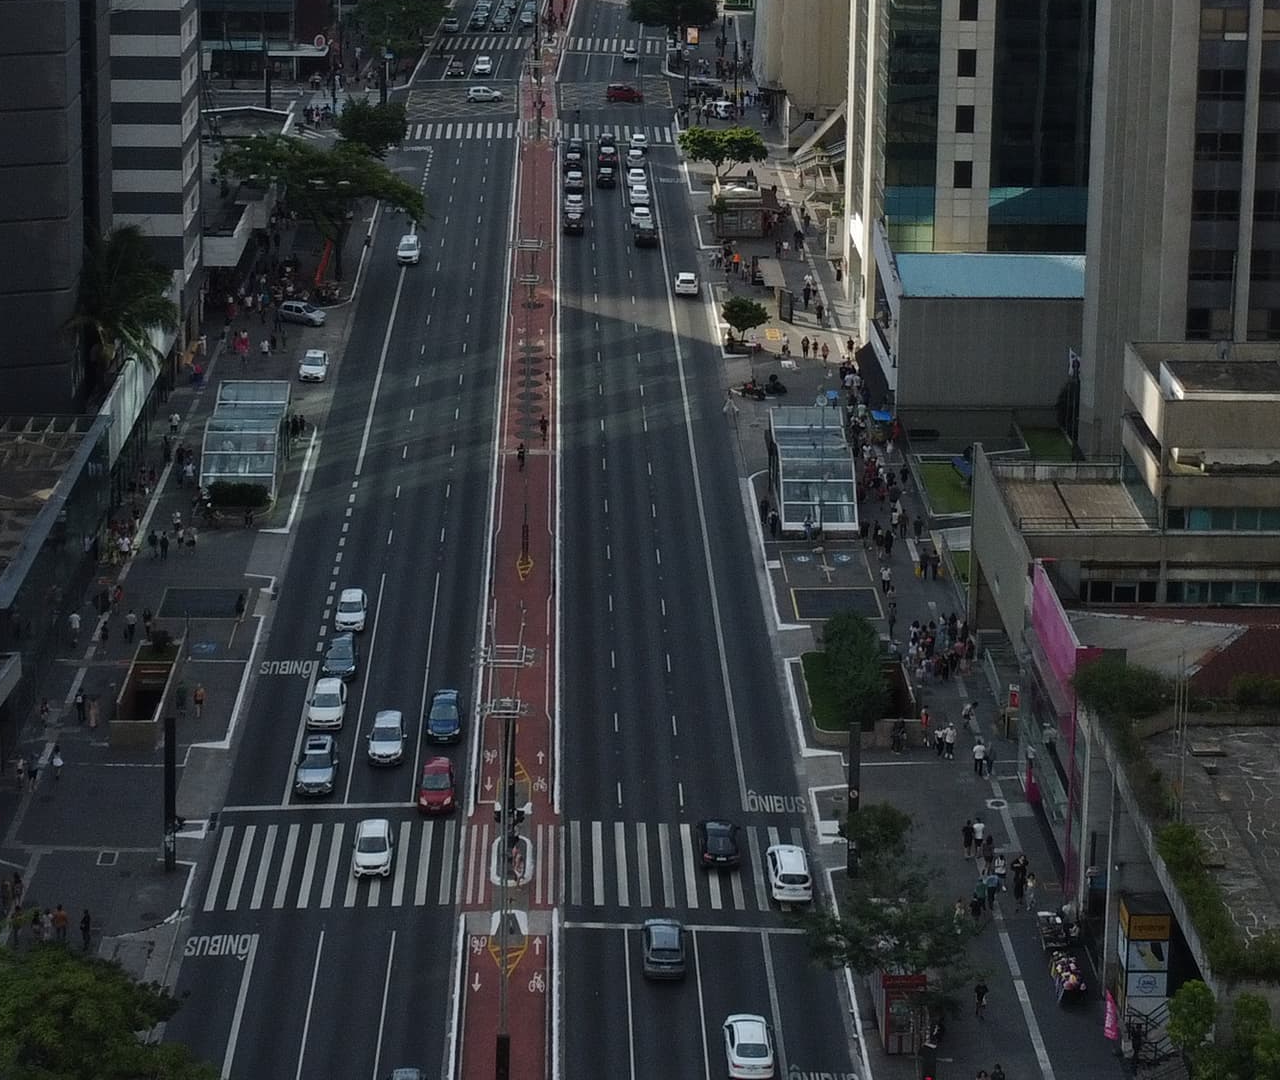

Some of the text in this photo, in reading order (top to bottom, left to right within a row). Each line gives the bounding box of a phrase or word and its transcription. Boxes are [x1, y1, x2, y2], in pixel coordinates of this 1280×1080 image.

[260, 660, 312, 678] ÔNIBUS
[747, 789, 806, 813] ÔNIBUS
[184, 934, 251, 960] ÔNIBUS
